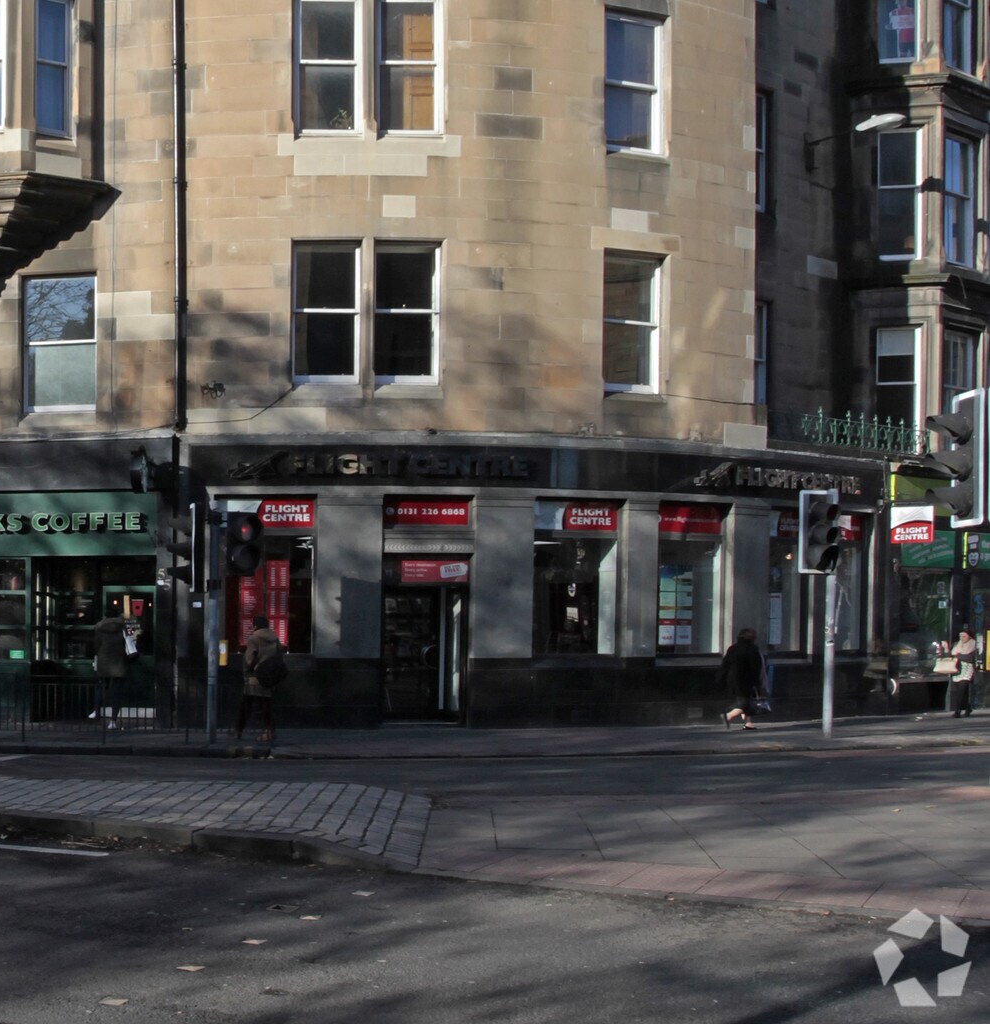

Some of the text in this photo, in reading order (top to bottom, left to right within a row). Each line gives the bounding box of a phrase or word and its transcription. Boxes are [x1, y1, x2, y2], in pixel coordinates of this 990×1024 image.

[415, 454, 530, 476] CENTRE
[264, 504, 309, 513] FLIGHT
[397, 507, 465, 516] 0131 226 6868
[572, 508, 610, 516] FLIGHT
[31, 511, 141, 532] COFFEE
[262, 513, 310, 522] CENTRE
[569, 517, 612, 526] CENTRE
[895, 526, 928, 534] FLIGHT
[894, 533, 929, 541] CENTRE
